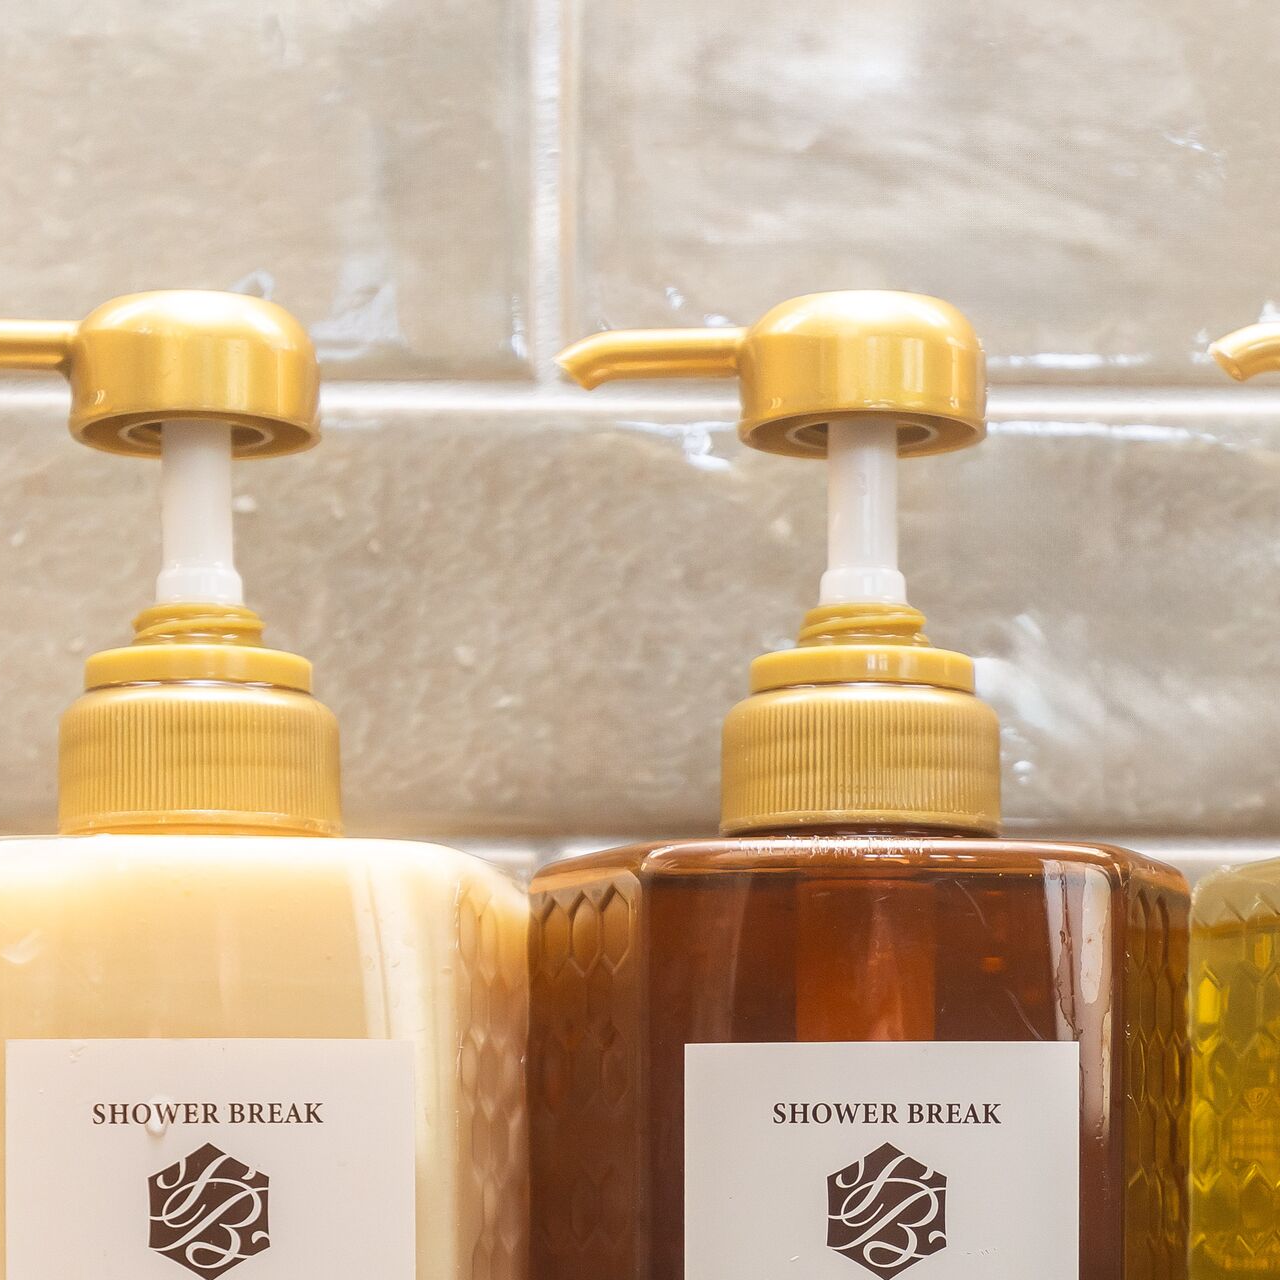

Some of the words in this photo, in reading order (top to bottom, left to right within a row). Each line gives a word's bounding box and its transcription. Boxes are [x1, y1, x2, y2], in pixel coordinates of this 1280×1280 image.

[92, 1103, 221, 1125] SHOWER
[228, 1102, 324, 1124] BREAK
[772, 1102, 900, 1124] SHOWER
[906, 1103, 1002, 1124] BREAK
